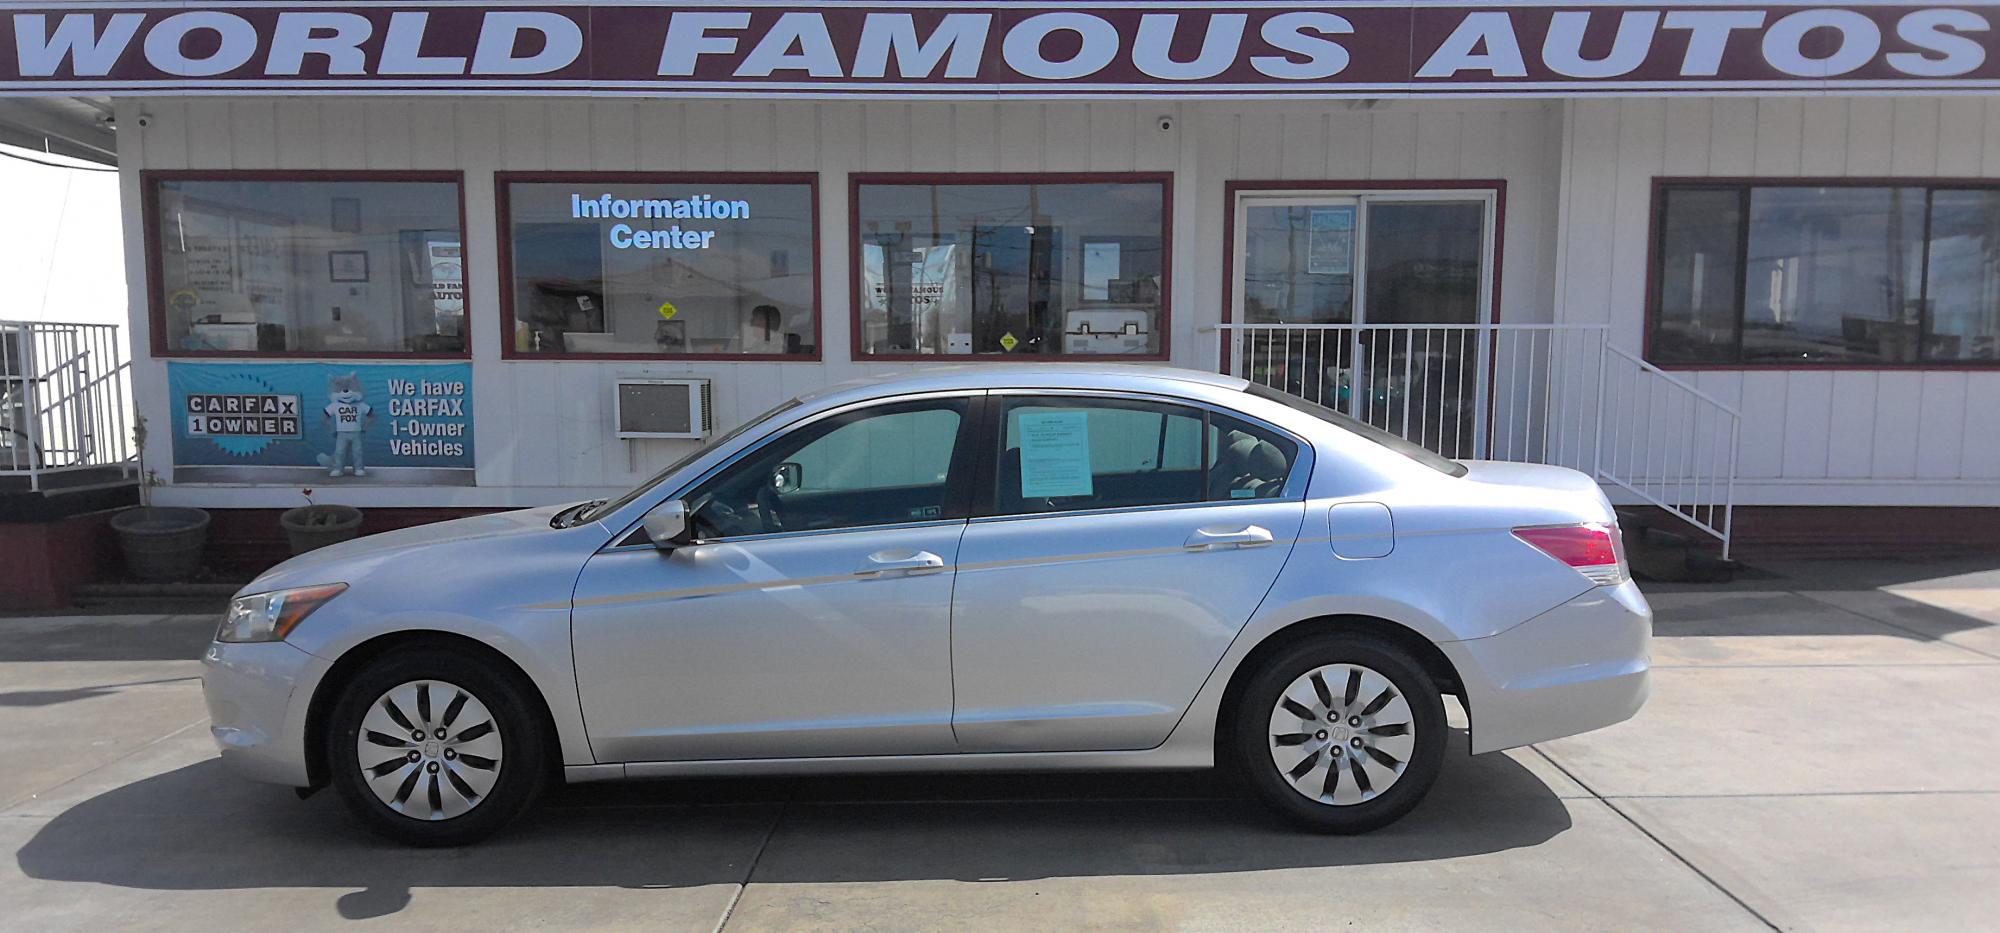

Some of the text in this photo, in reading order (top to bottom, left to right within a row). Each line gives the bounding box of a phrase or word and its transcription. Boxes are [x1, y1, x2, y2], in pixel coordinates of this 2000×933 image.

[13, 8, 1991, 80] WORLD FAMOUS AUTOS
[571, 193, 750, 220] Information
[609, 223, 716, 250] Center
[387, 379, 464, 396] We have
[190, 397, 294, 415] CARFAX
[338, 406, 358, 415] CAR
[388, 398, 464, 417] CARFAX
[192, 418, 295, 433] 1 OWNER
[340, 414, 358, 423] FOX
[389, 419, 465, 437] 1-Owner
[389, 439, 464, 457] Vehicles
